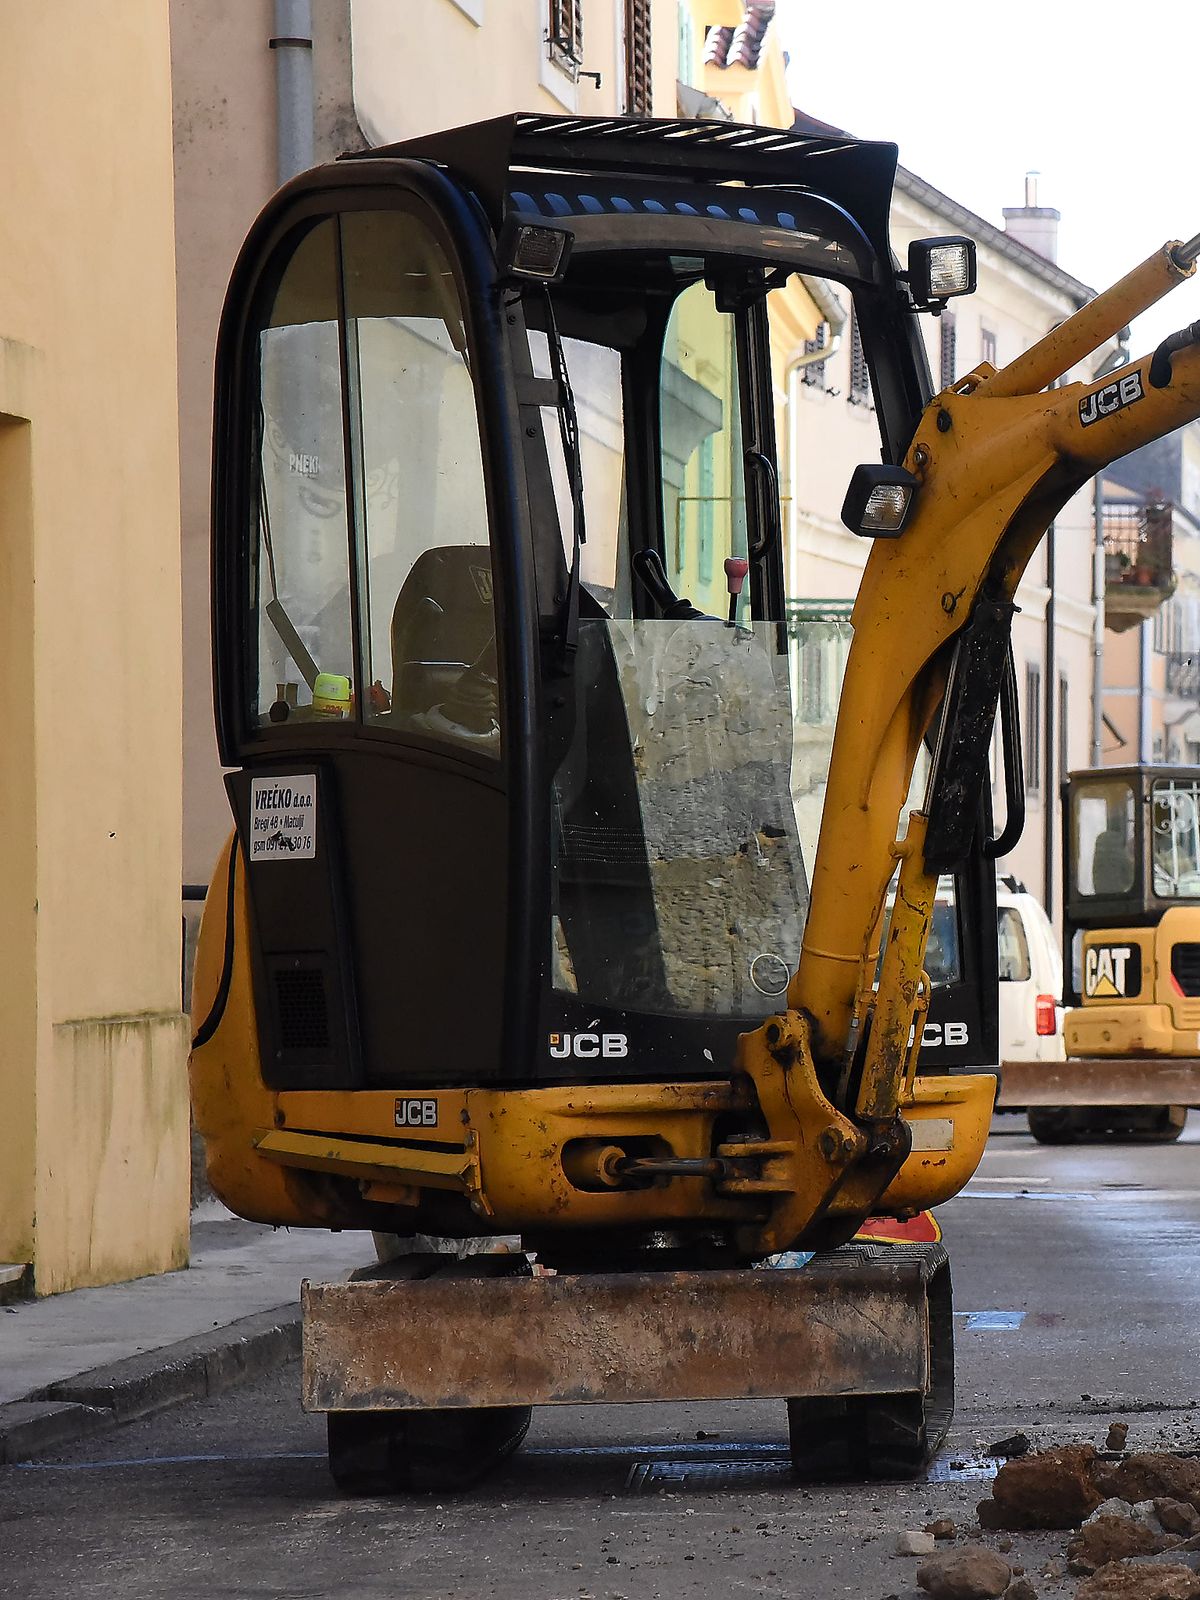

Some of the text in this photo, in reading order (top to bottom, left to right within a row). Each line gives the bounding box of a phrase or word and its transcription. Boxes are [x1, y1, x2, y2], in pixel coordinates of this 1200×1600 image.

[1080, 373, 1142, 423] JCB
[255, 784, 313, 810] VREČKO d.o.o.
[1086, 948, 1131, 997] CAT
[550, 1033, 628, 1058] JCB
[395, 1100, 437, 1125] JCB
